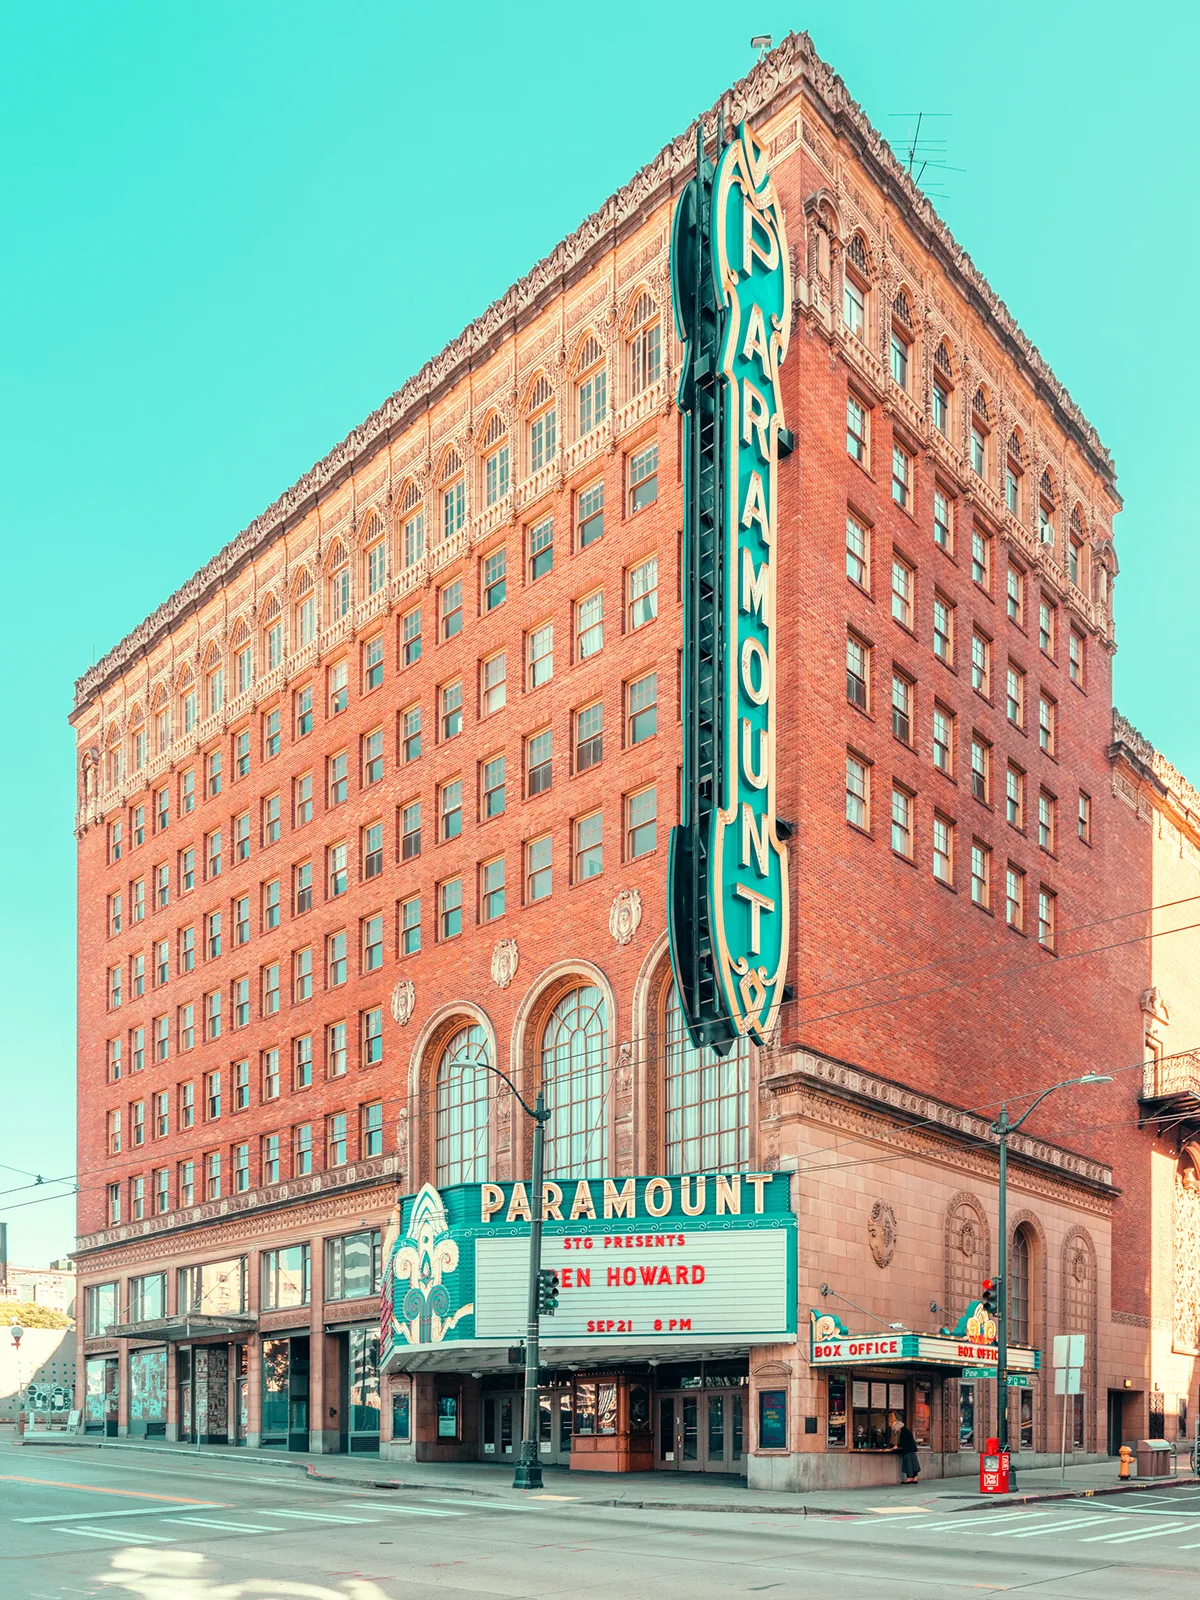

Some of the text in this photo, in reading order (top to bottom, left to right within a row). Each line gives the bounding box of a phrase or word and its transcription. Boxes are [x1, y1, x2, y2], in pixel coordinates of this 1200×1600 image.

[732, 198, 779, 956] PARAMOUNT
[480, 1174, 773, 1223] PARAMOUNT
[563, 1234, 686, 1250] STG PRESENTS
[607, 1265, 706, 1287] HOWARD
[653, 1319, 663, 1331] 8
[668, 1318, 692, 1331] PM
[814, 1341, 898, 1358] BOX OFFICE
[958, 1346, 998, 1360] BOX OFFIC
[965, 1369, 978, 1377] Pine
